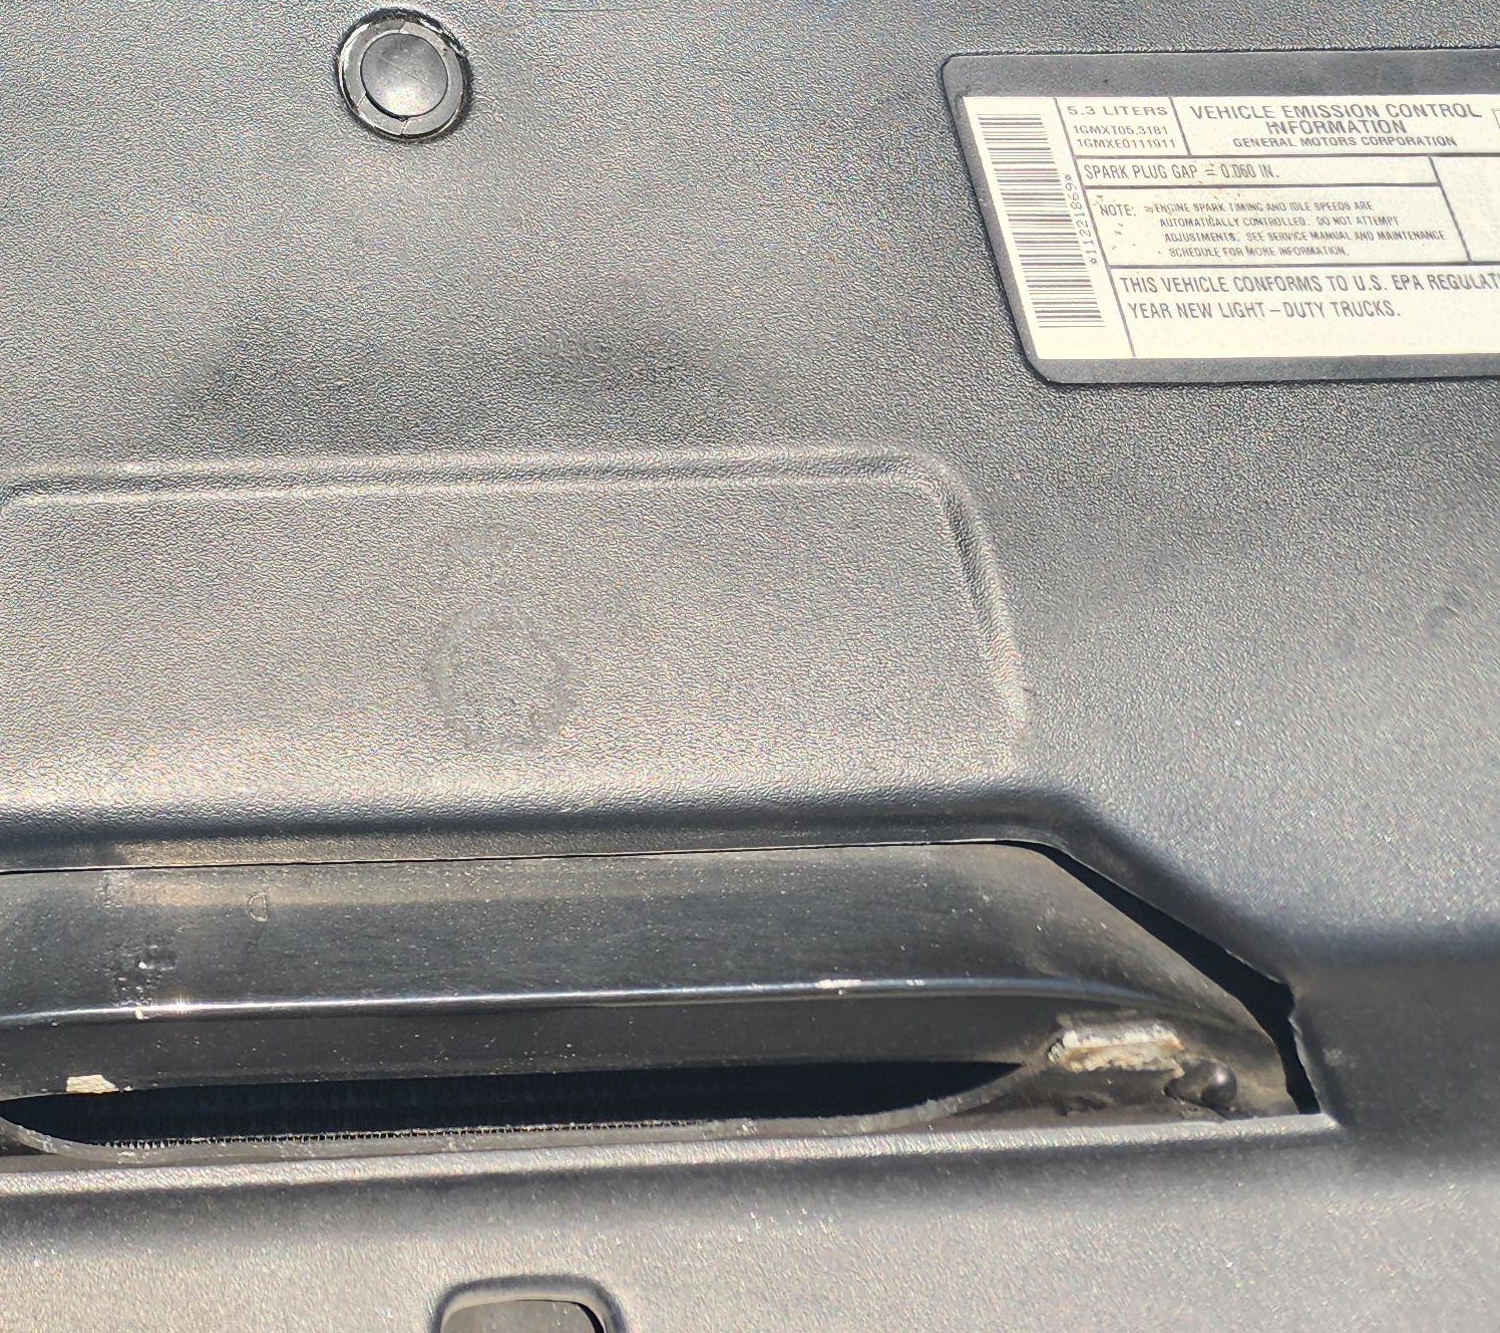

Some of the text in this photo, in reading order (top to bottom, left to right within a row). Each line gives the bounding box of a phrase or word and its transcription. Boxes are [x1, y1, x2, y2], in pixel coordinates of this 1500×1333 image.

[1066, 105, 1169, 116] 5.3 LITERS
[1190, 102, 1483, 120] VEHICLE EMISSION CONTROL
[1266, 119, 1408, 135] INFORMATION
[1233, 135, 1458, 149] GENERAL MOTORS CORPORATION
[1084, 164, 1129, 180] SPARK
[1133, 164, 1168, 180] PLUG
[1172, 163, 1198, 179] GAP
[1220, 163, 1257, 179] 0.060
[1259, 163, 1281, 179] IN.
[1100, 200, 1373, 218] NOTE: ENGINE SPARK TIMING AND IDLE SPEEDS ARE
[1159, 215, 1400, 228] AUTOMATICALLY CONTROLLED. DO NOT ATTEMPT
[1164, 229, 1446, 243] ADJUSTMENTS. SEE SERVICE MANUAL AND MAINTENANCE
[1169, 245, 1351, 259] SCHEDULE FOR MORE INFORMATION.
[1119, 275, 1157, 294] THIS
[1160, 275, 1229, 294] VEHICLE
[1233, 275, 1324, 293] CONFORMS
[1325, 275, 1349, 292] TO
[1352, 275, 1389, 292] U.S.
[1391, 274, 1425, 291] EPA
[1127, 302, 1172, 320] YEAR
[1175, 302, 1214, 319] NEW
[1329, 300, 1403, 318] TRUCKS.
